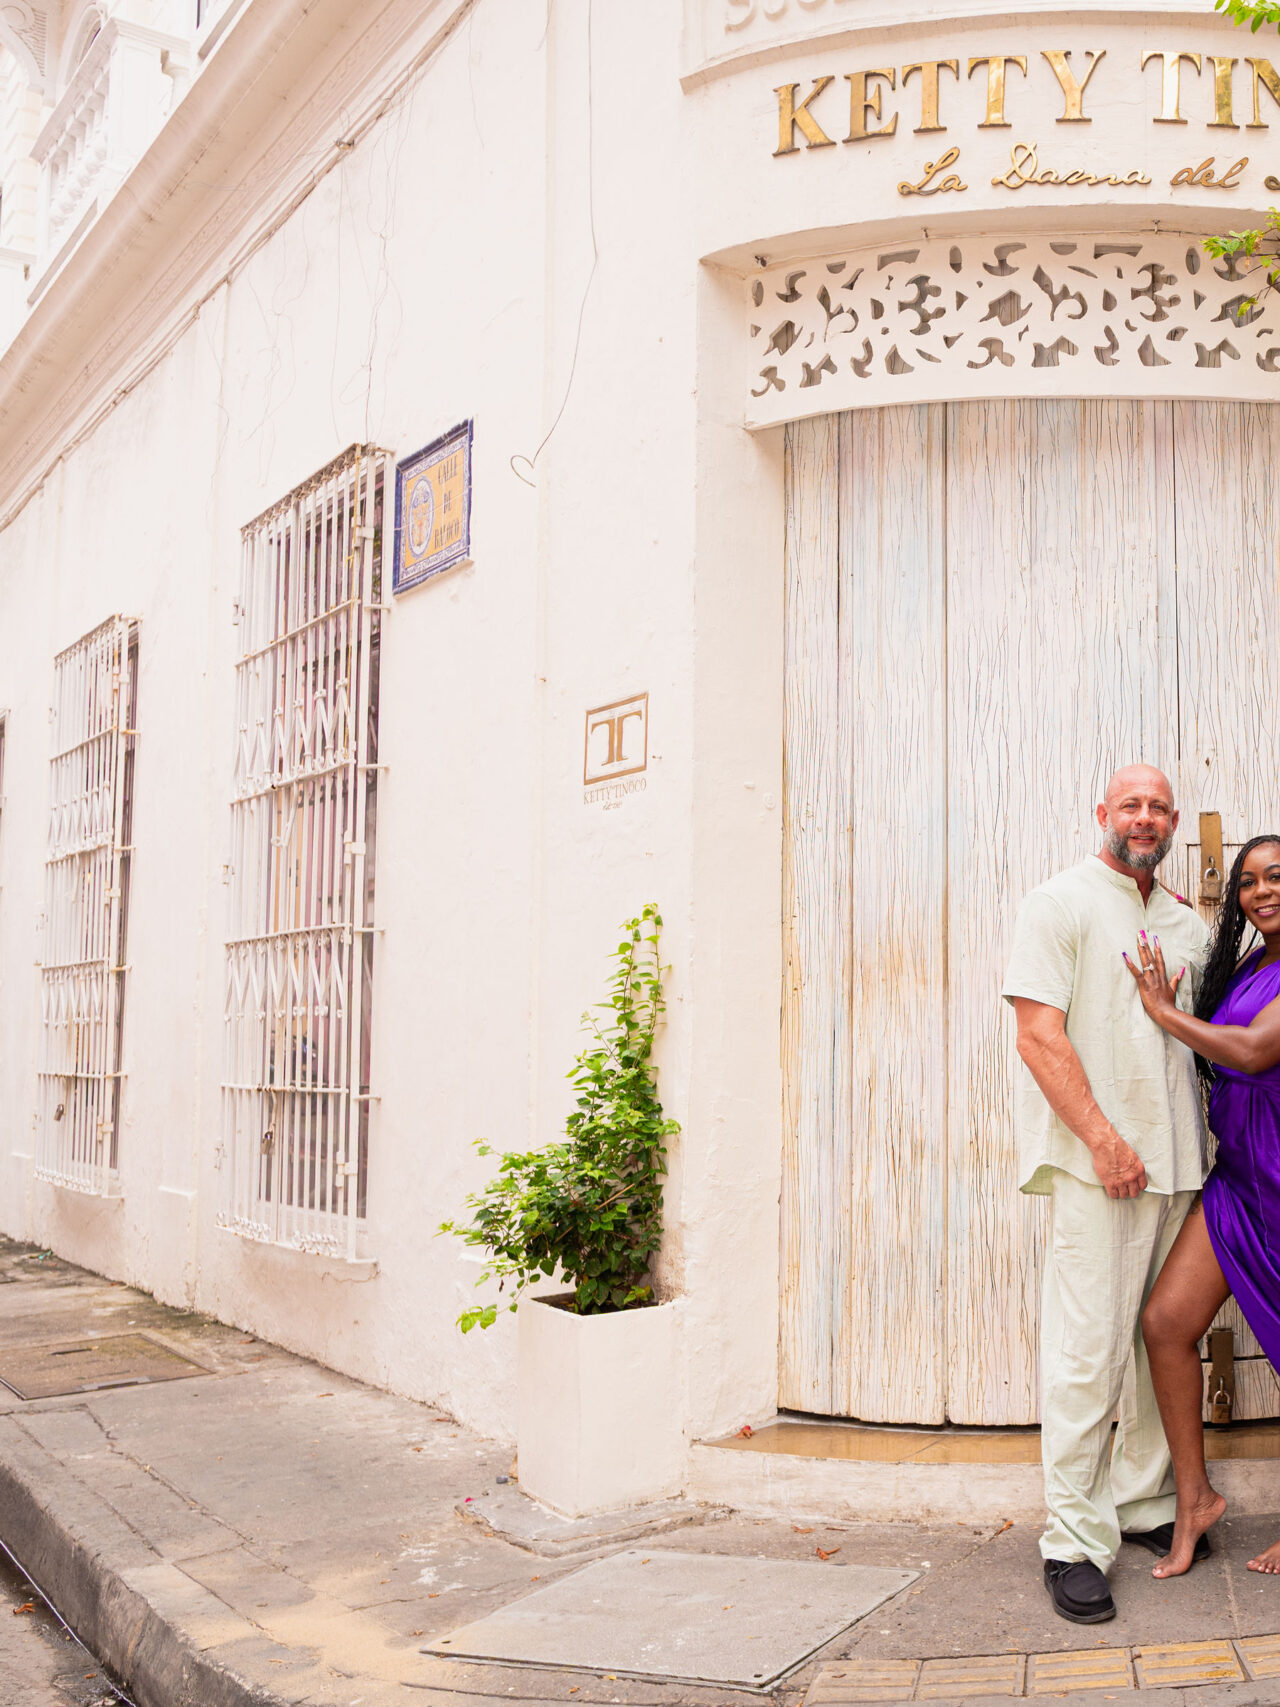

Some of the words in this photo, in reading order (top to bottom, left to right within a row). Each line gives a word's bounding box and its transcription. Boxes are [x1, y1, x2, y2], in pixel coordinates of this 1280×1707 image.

[772, 49, 1107, 157] KETTY
[897, 146, 969, 196] La
[991, 141, 1152, 189] Dama
[1170, 156, 1249, 189] del
[438, 455, 458, 485] CALLE
[443, 490, 452, 515] DE
[584, 786, 612, 805] KETTY
[613, 778, 647, 798] TINOCO
